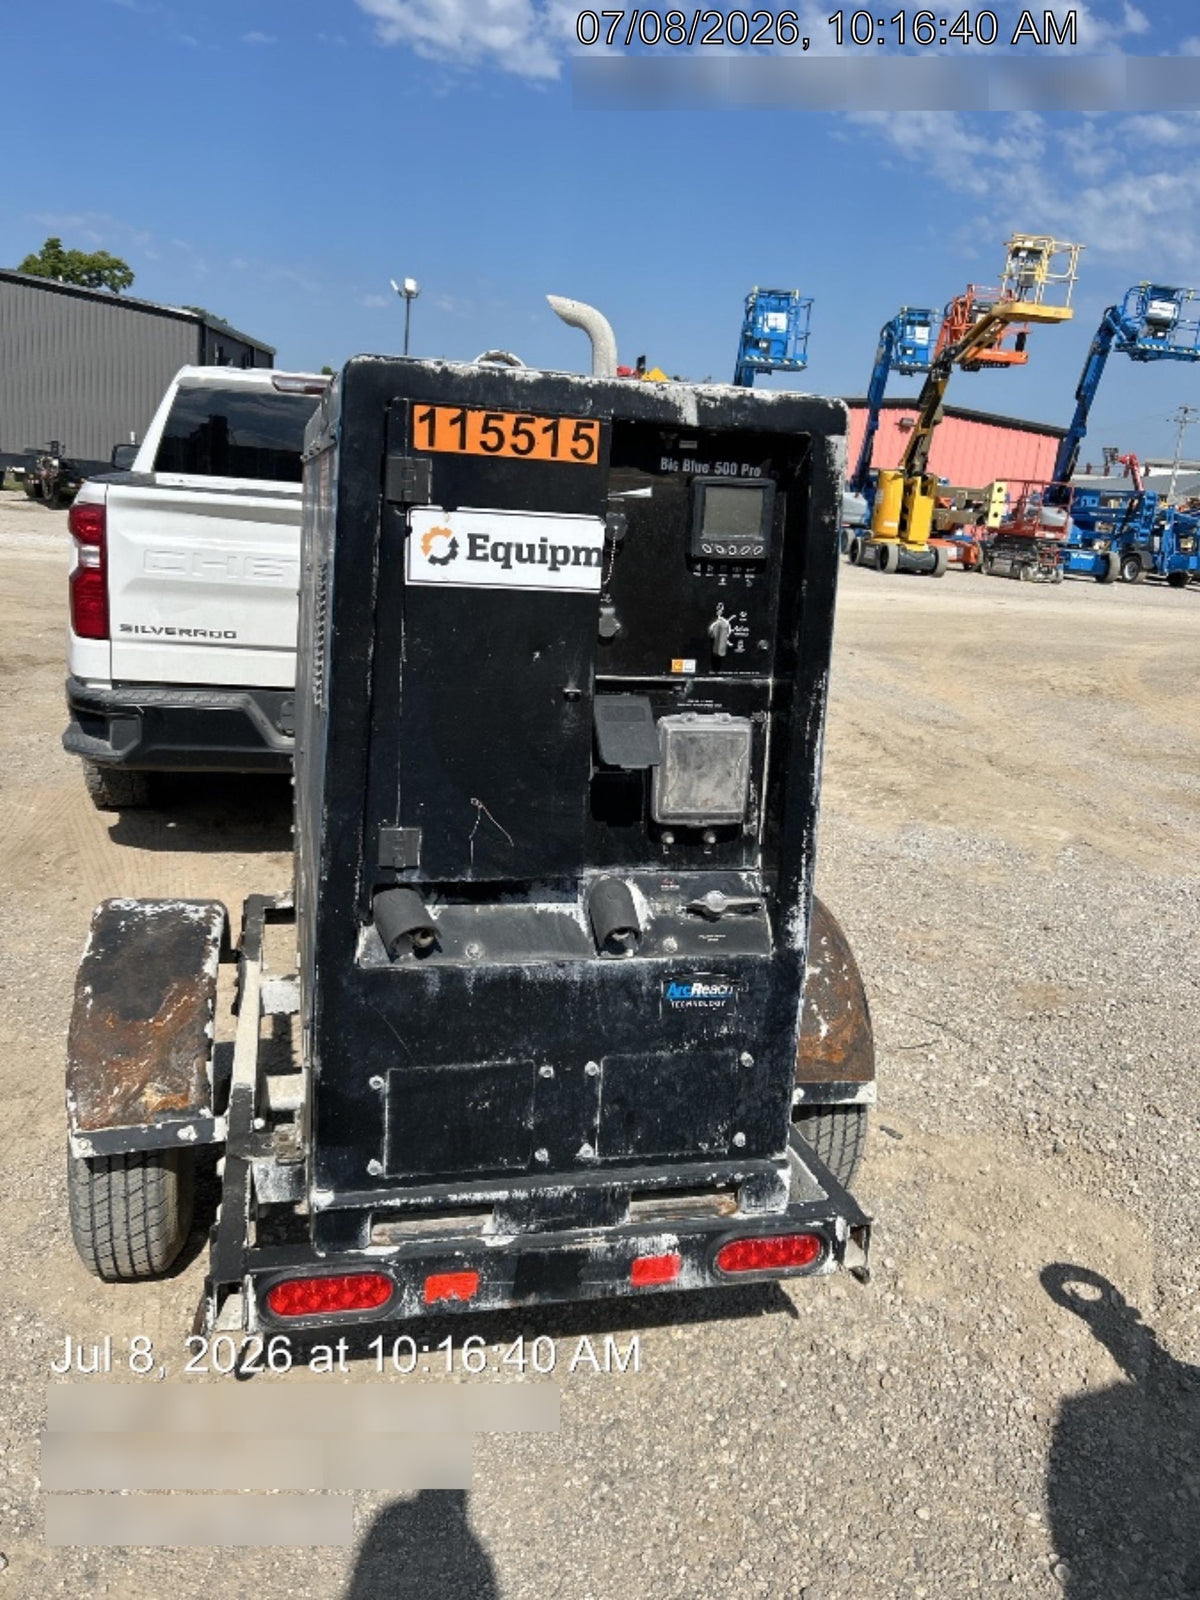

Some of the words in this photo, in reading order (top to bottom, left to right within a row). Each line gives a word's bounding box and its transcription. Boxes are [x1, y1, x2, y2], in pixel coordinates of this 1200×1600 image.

[419, 407, 595, 461] 115515
[660, 456, 679, 472] Big
[682, 458, 710, 474] Blue
[714, 461, 738, 476] 500
[741, 463, 762, 478] Pro
[467, 532, 603, 573] Equipm
[119, 623, 237, 639] SILVERADO
